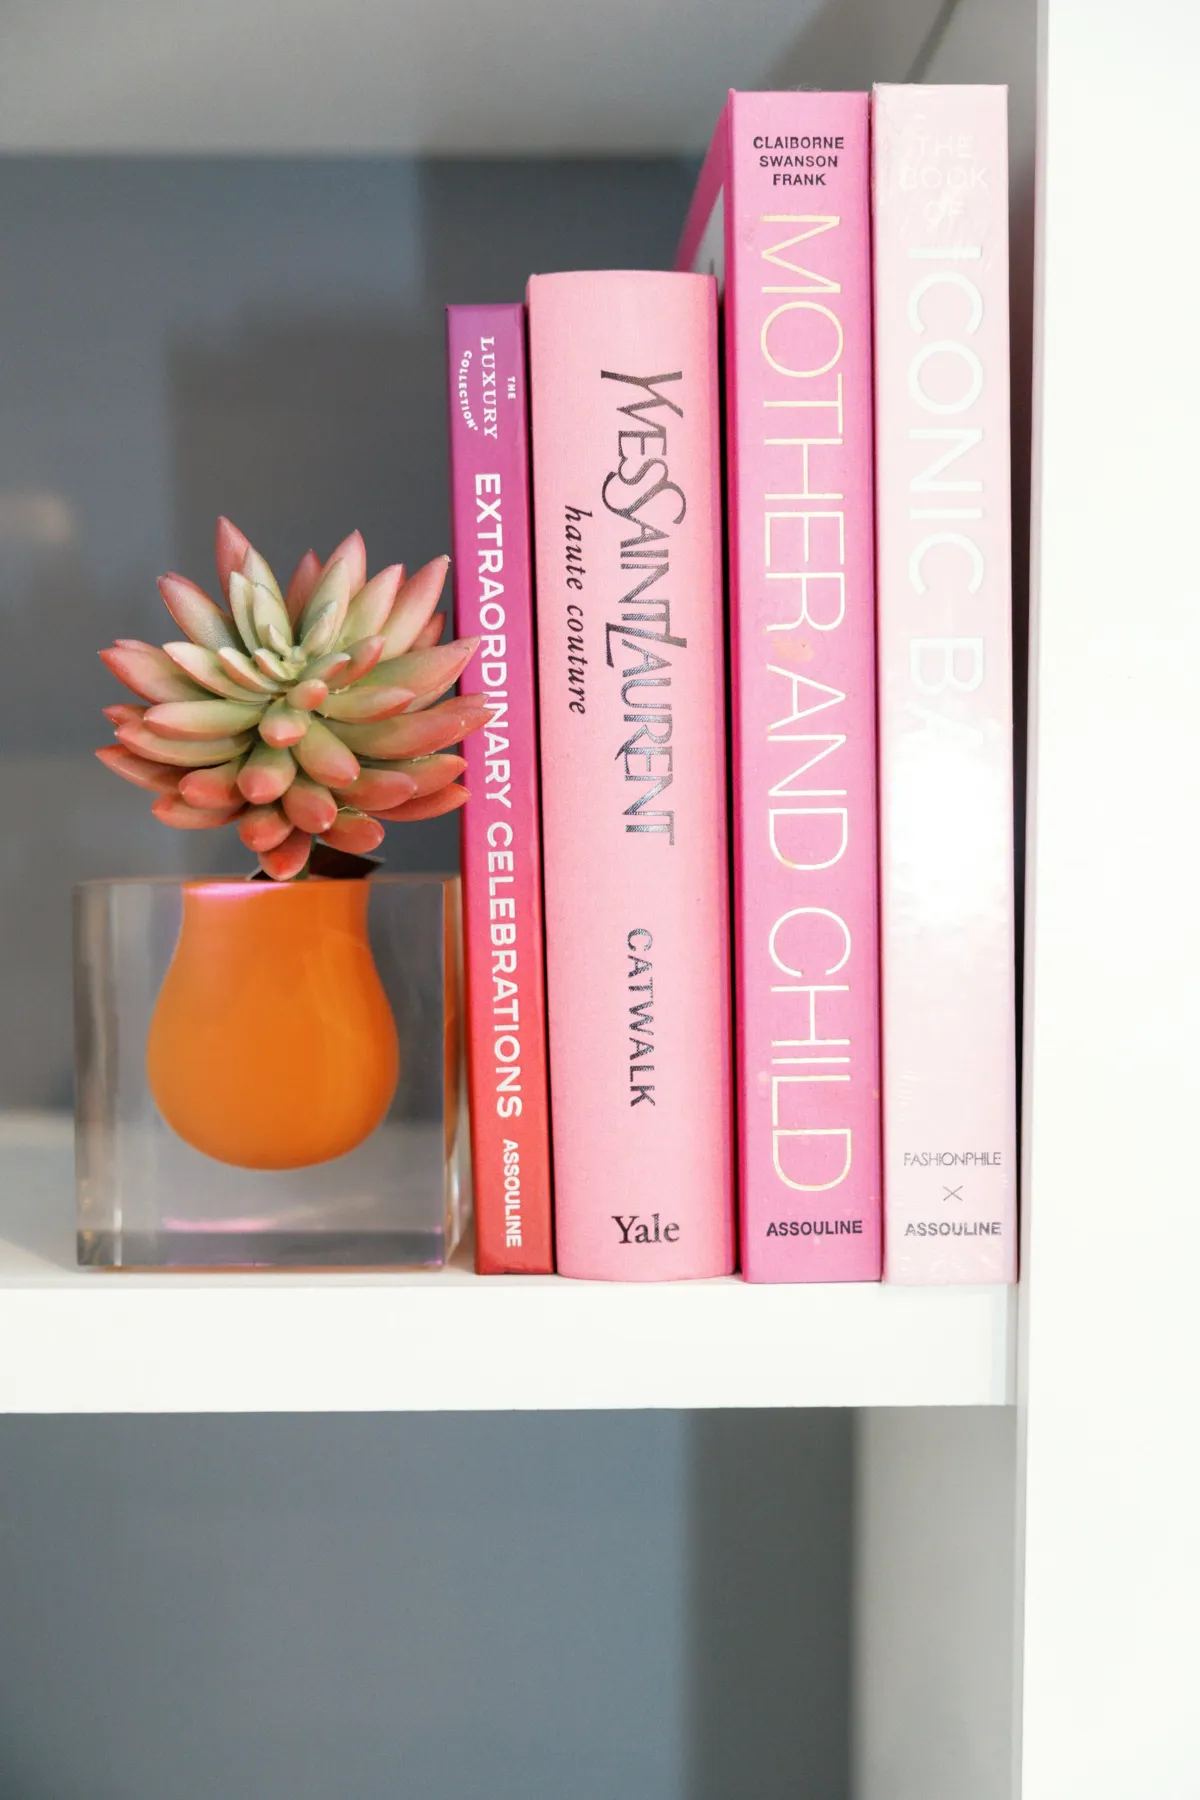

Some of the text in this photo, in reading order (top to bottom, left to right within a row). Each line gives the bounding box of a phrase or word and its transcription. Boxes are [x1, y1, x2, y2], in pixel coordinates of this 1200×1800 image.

[753, 136, 845, 150] CLAIBORNE
[916, 135, 975, 159] THE
[759, 154, 839, 168] SWANSON
[772, 172, 826, 187] FRANK
[898, 166, 989, 192] BOOK
[480, 336, 498, 440] LUXURY
[507, 376, 517, 400] THE
[906, 246, 984, 596] ICONIC
[564, 504, 593, 716] haute couture
[760, 214, 852, 1192] MOTHER AND CHILD
[475, 473, 523, 1119] EXTRAORDINARY CELEBRATIONS
[626, 926, 656, 1108] CATWALK
[904, 1152, 1002, 1167] FASHIONPHILE
[502, 1138, 523, 1249] ASSOULINE
[611, 1213, 681, 1246] Yale
[766, 1219, 863, 1237] ASSOULINE
[904, 1221, 1003, 1237] ASSOULINE
